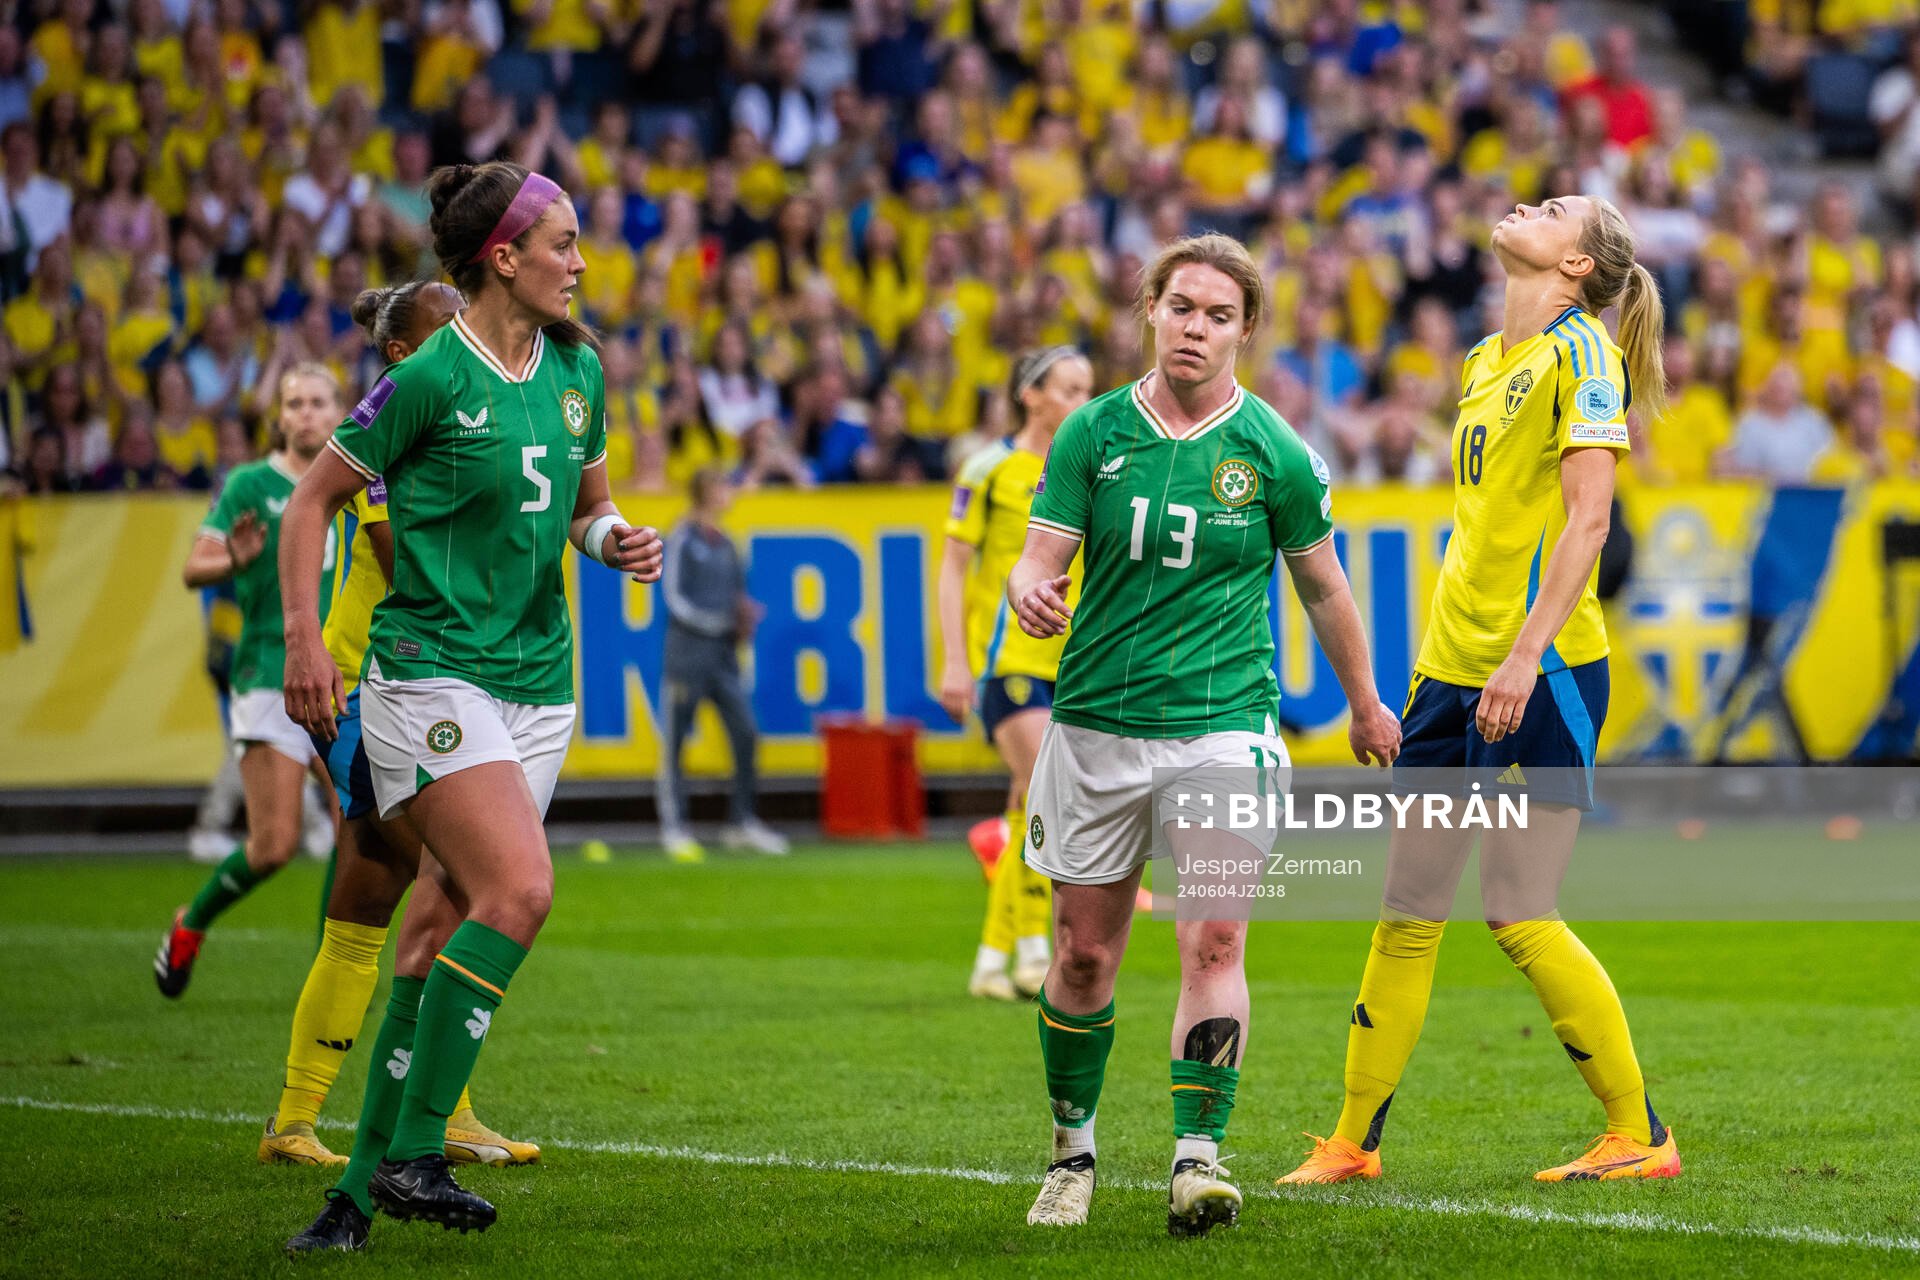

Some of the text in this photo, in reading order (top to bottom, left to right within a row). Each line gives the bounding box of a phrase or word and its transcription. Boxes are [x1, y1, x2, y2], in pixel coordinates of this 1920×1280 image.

[460, 427, 490, 436] CASTORE
[1572, 429, 1626, 437] FOUNDATION
[1460, 424, 1487, 486] 18
[520, 446, 551, 512] 5
[1219, 463, 1255, 481] IRELAND
[1214, 518, 1232, 526] JUNE
[1129, 496, 1197, 569] 13
